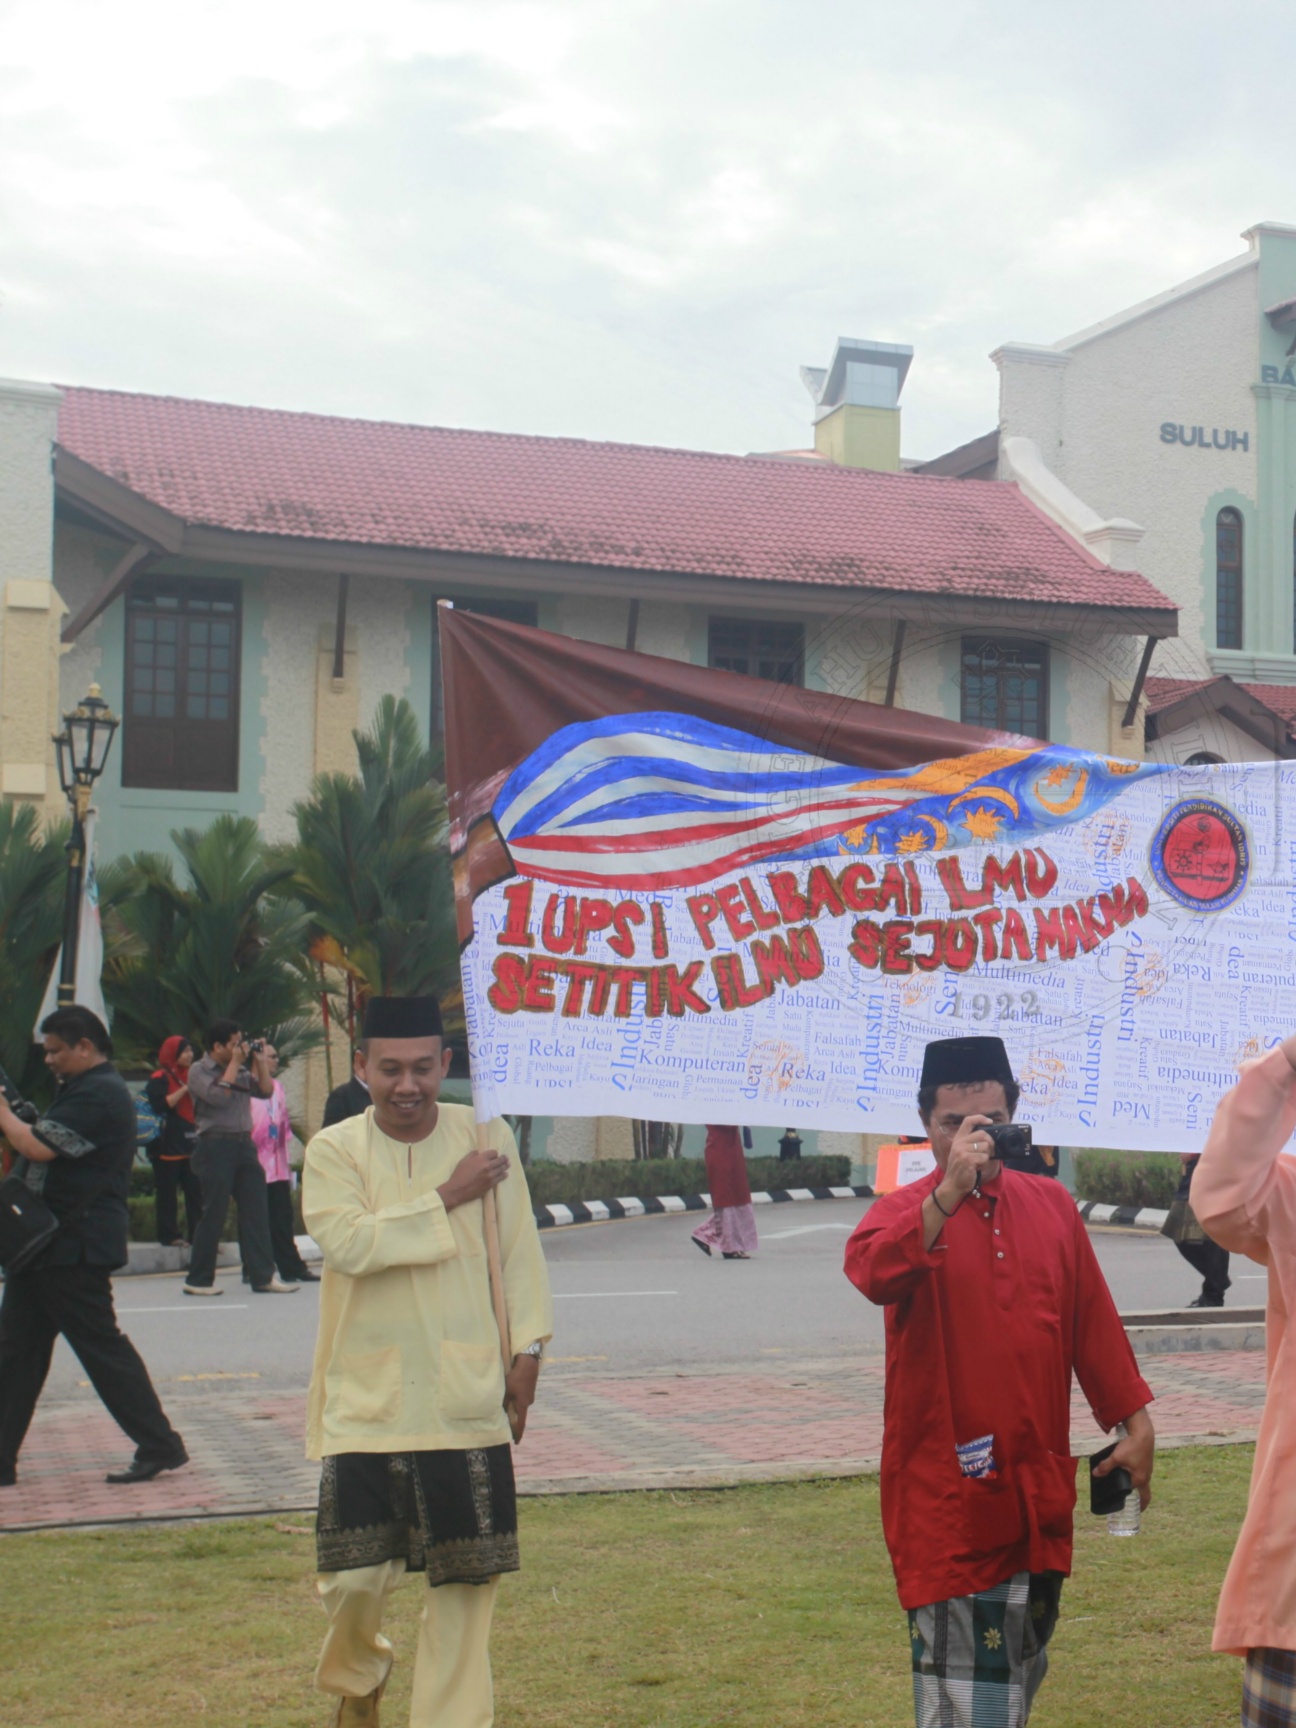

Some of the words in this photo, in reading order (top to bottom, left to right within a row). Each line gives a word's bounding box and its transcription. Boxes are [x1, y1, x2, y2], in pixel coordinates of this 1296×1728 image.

[1160, 422, 1249, 452] SULUH
[1063, 879, 1090, 894] Idea
[686, 860, 922, 951] PELBAGAI
[937, 847, 1058, 911] ILMU
[1261, 900, 1286, 913] Idea
[488, 952, 711, 1018] SETITIK
[711, 925, 826, 1011] ILMU
[973, 960, 1067, 990] Multimedia
[1172, 962, 1212, 983] Reka
[777, 988, 842, 1013] Jabatan
[1005, 1004, 1065, 1028] Jabatan
[899, 1019, 965, 1038] Multimedia
[1158, 1028, 1220, 1049] Jabatan
[528, 1037, 577, 1059] Reka
[580, 1035, 614, 1053] Idea
[813, 1031, 863, 1048] Falsafah
[814, 1045, 837, 1059] Arca
[837, 1046, 857, 1060] Asli
[535, 1061, 574, 1076] Pelbagai
[640, 1049, 747, 1080] Komputeran
[779, 1060, 828, 1084] Reka
[829, 1059, 858, 1076] Idea
[695, 1073, 744, 1090] Permainan
[1051, 1075, 1079, 1092] Idea
[1186, 1090, 1204, 1131] Seni
